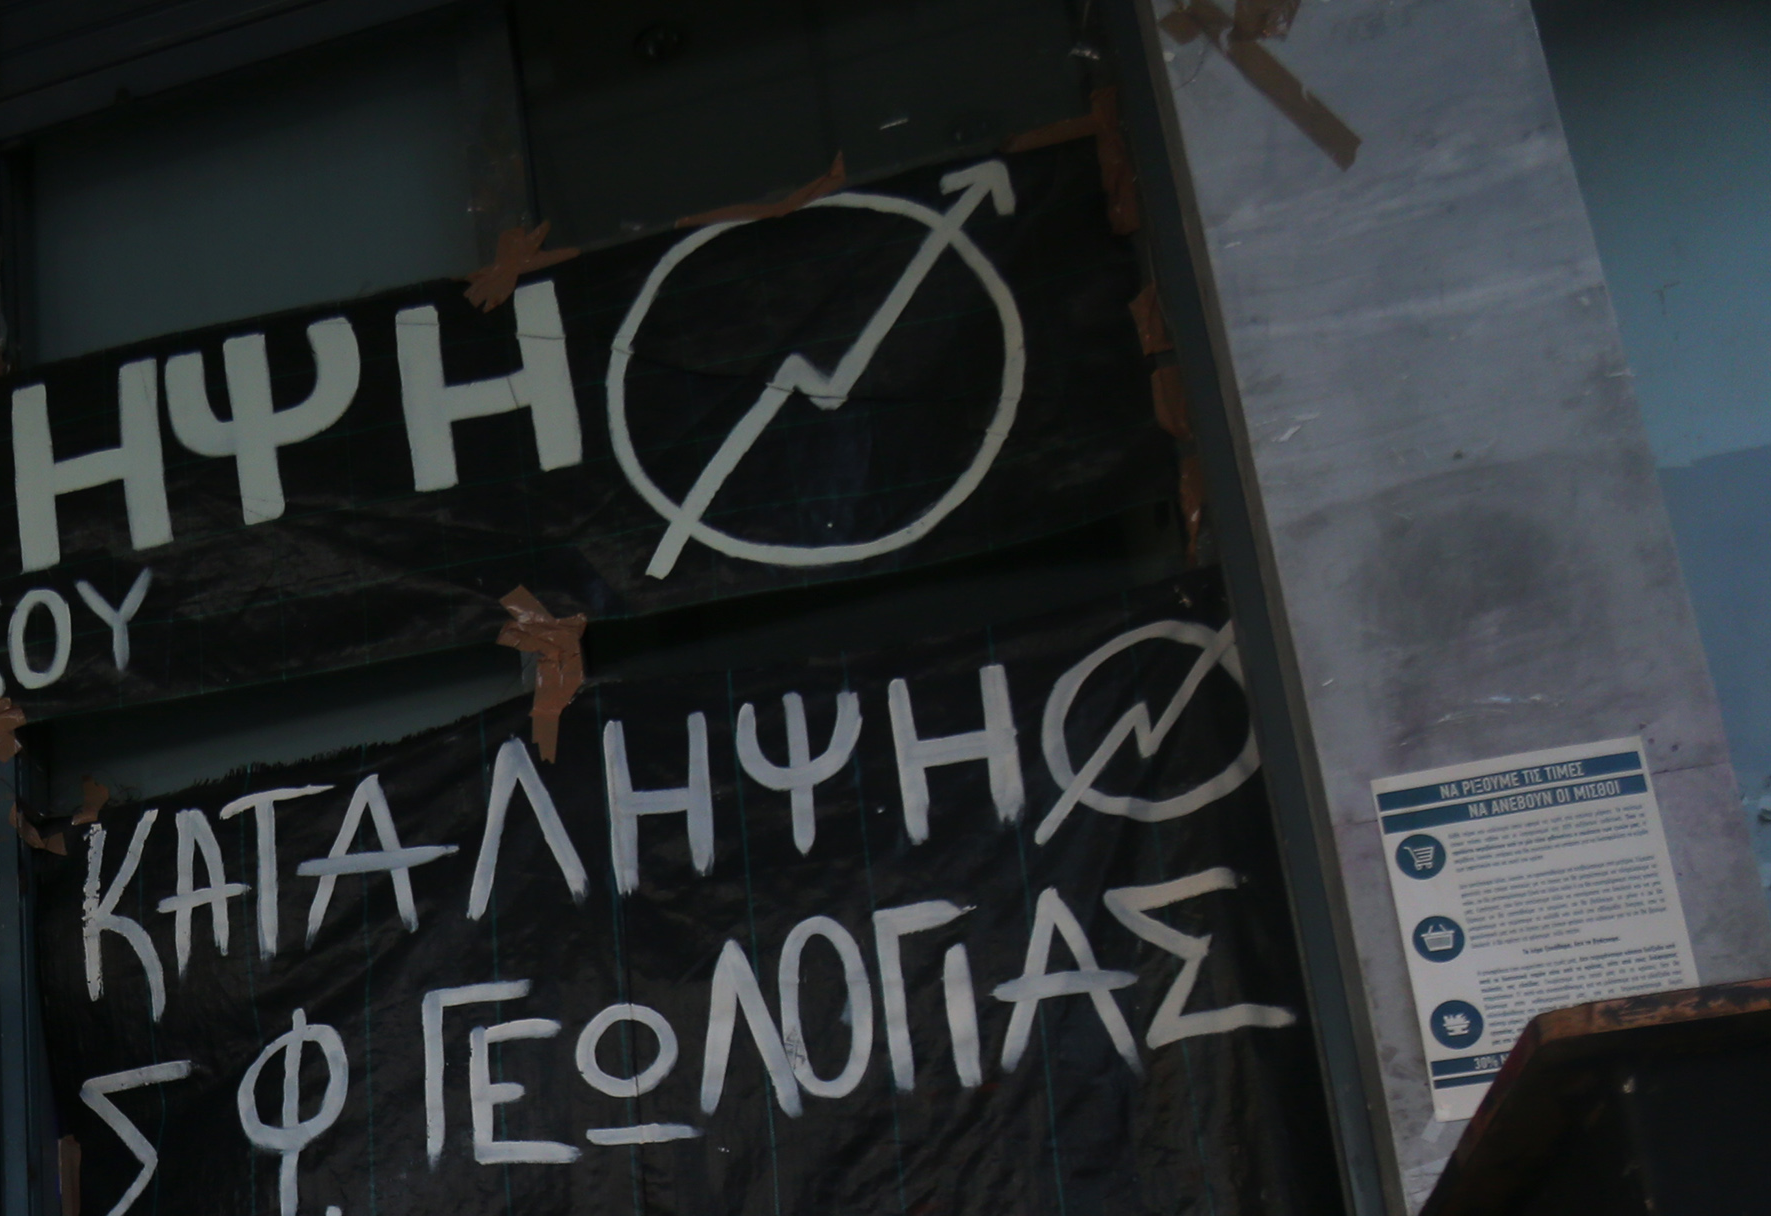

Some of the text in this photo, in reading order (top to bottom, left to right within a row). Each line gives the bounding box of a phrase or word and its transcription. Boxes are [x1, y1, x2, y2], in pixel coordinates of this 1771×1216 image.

[82, 664, 1028, 1023] ΚΑΤΑΛΗΨΗ
[1440, 761, 1585, 800] ΝΑ ΡΙΞΟΥΜΕ ΤΙΣ ΤΙΜΕΣ
[1468, 780, 1621, 818] ΝΑ ΑΝΕΒΟΥΝ ΟΙ ΜΙΣΘΟΙ
[421, 868, 1298, 1167] ΓΕΩΛΟΓΙΑΣ
